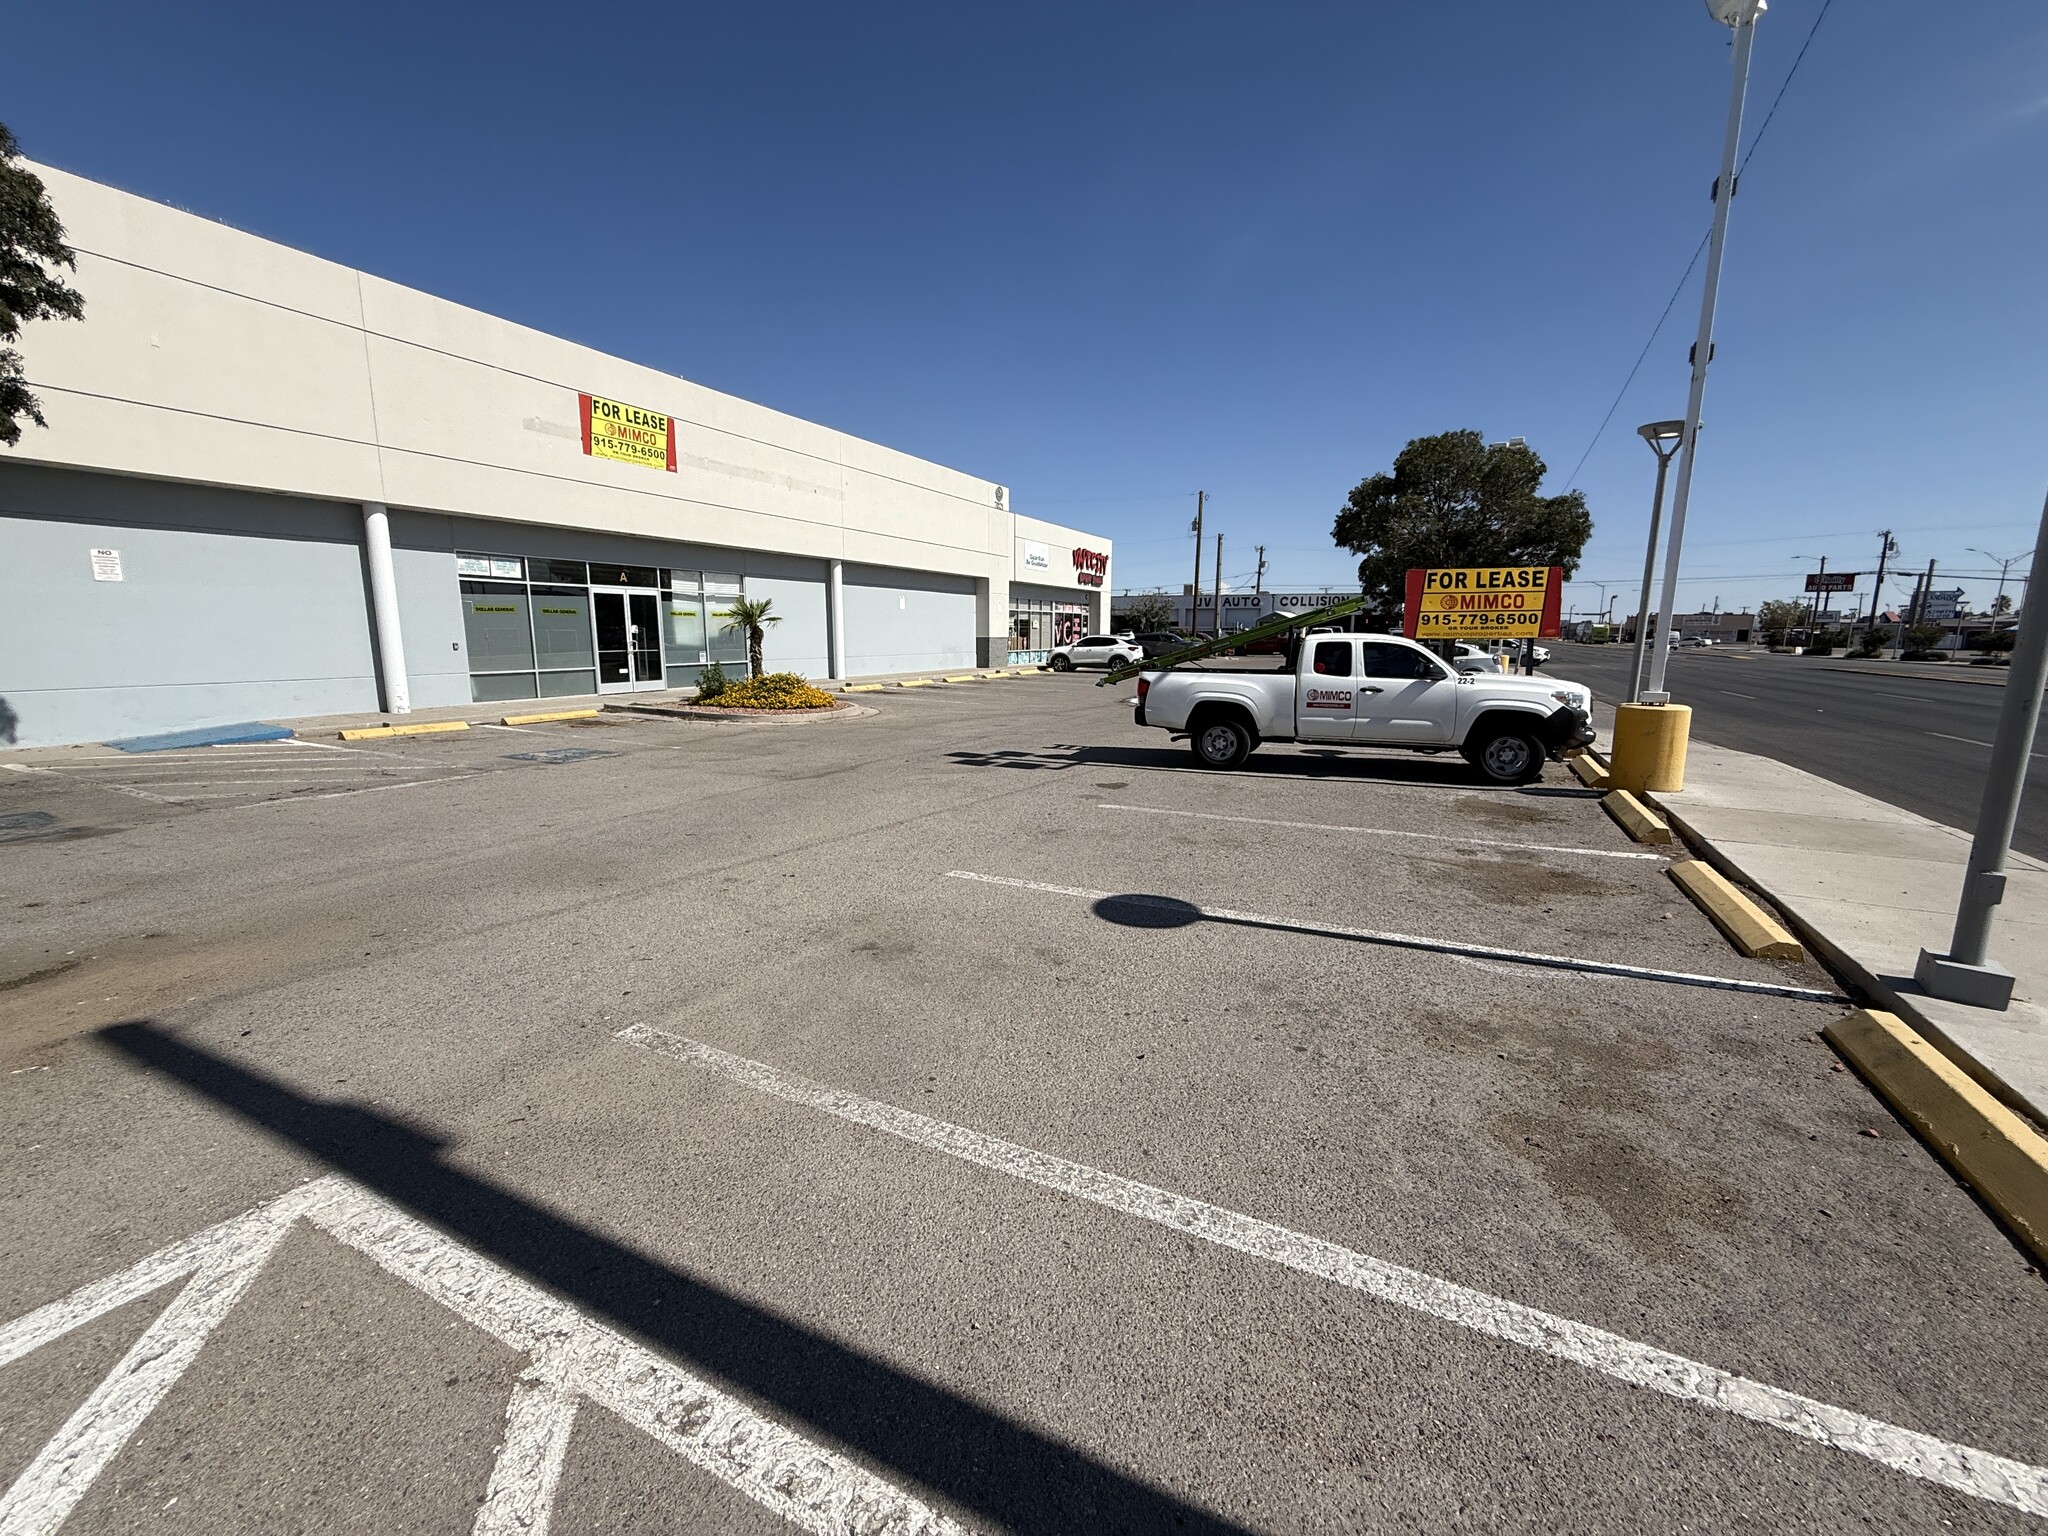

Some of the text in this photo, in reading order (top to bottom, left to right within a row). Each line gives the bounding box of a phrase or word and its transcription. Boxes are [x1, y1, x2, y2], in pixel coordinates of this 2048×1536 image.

[593, 399, 666, 432] FOR LEASE
[617, 425, 657, 446] MIMCO
[593, 436, 665, 460] 915-779-6500
[619, 572, 628, 582] A
[1426, 570, 1544, 589] FOR LEASE
[1197, 596, 1350, 607] JV AUTO COLLISION
[1460, 593, 1525, 610] MIMCO
[1421, 612, 1538, 625] 915-779-6500
[1457, 677, 1475, 685] 22-2
[1320, 691, 1352, 701] MIMCO
